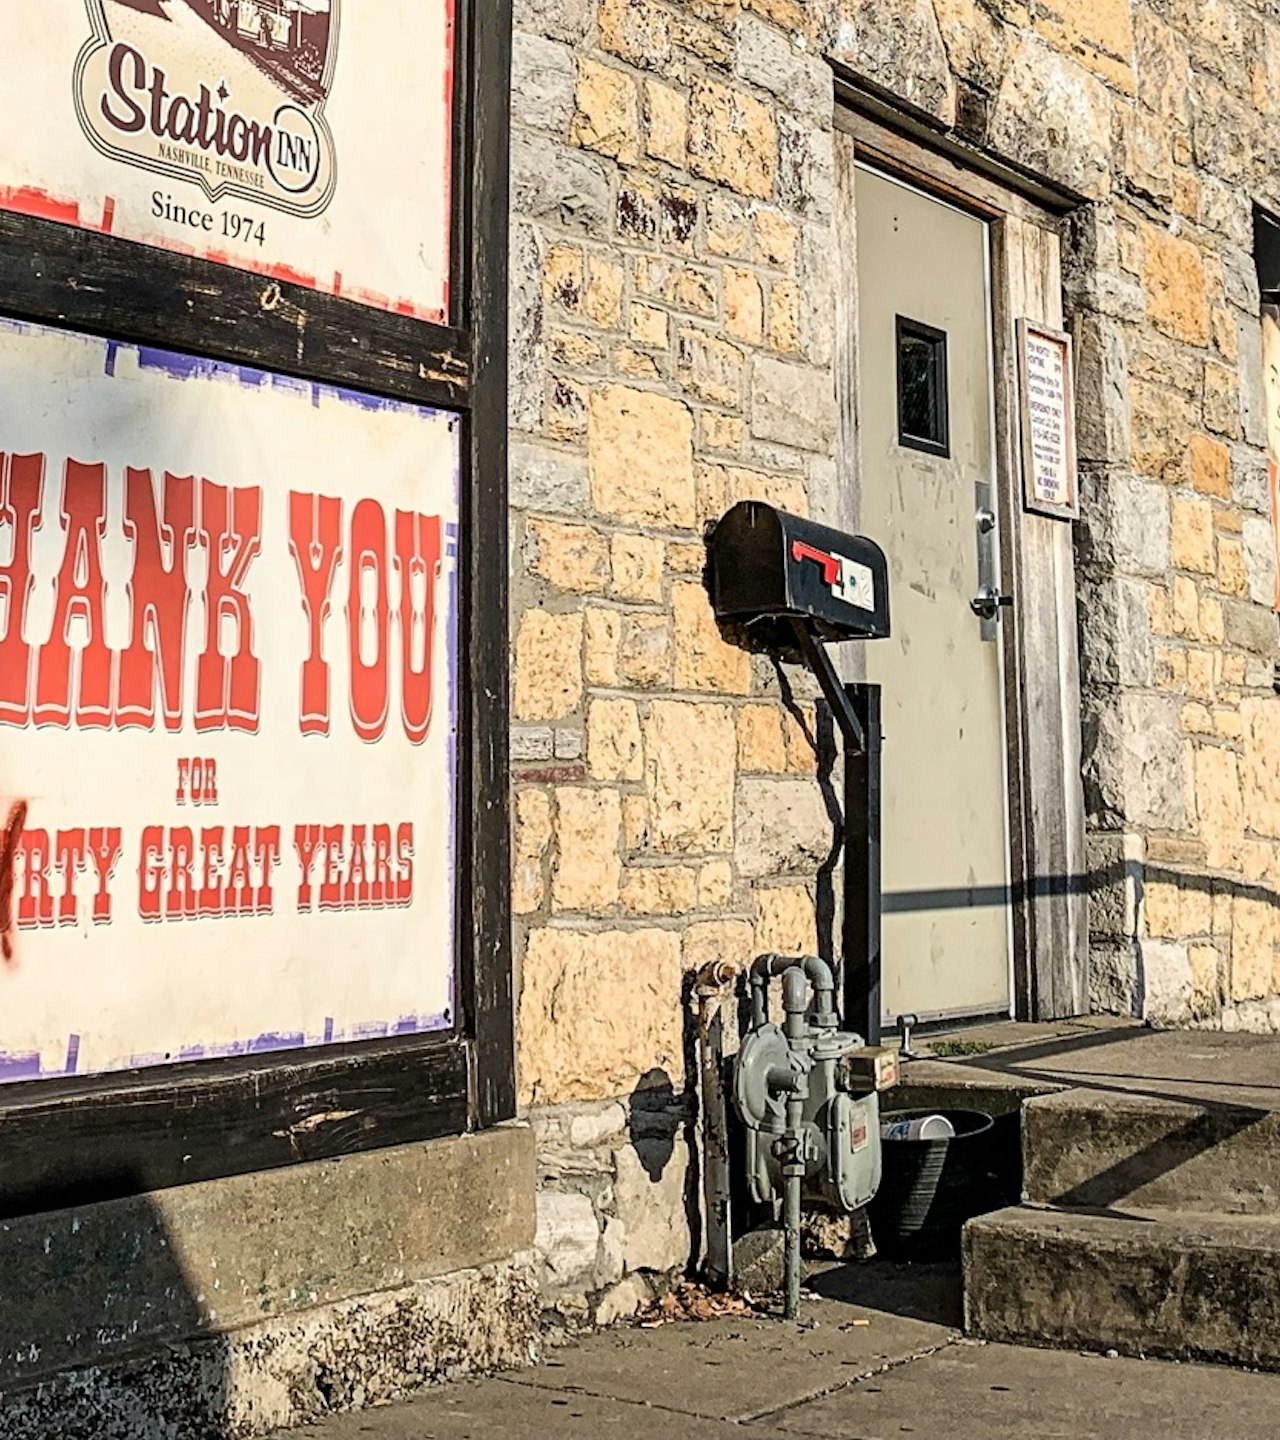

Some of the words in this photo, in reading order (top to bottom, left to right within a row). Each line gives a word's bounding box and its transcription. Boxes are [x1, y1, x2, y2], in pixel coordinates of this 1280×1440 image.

[101, 42, 273, 167] Station
[277, 131, 312, 174] INN
[158, 144, 212, 174] NASHVILLE,
[216, 160, 265, 189] TENNESSEE
[151, 190, 214, 232] Since
[221, 210, 266, 247] 1974
[288, 489, 441, 745] YOU
[176, 756, 219, 807] FOR
[137, 825, 281, 923] GREAT
[293, 821, 415, 914] YEARS
